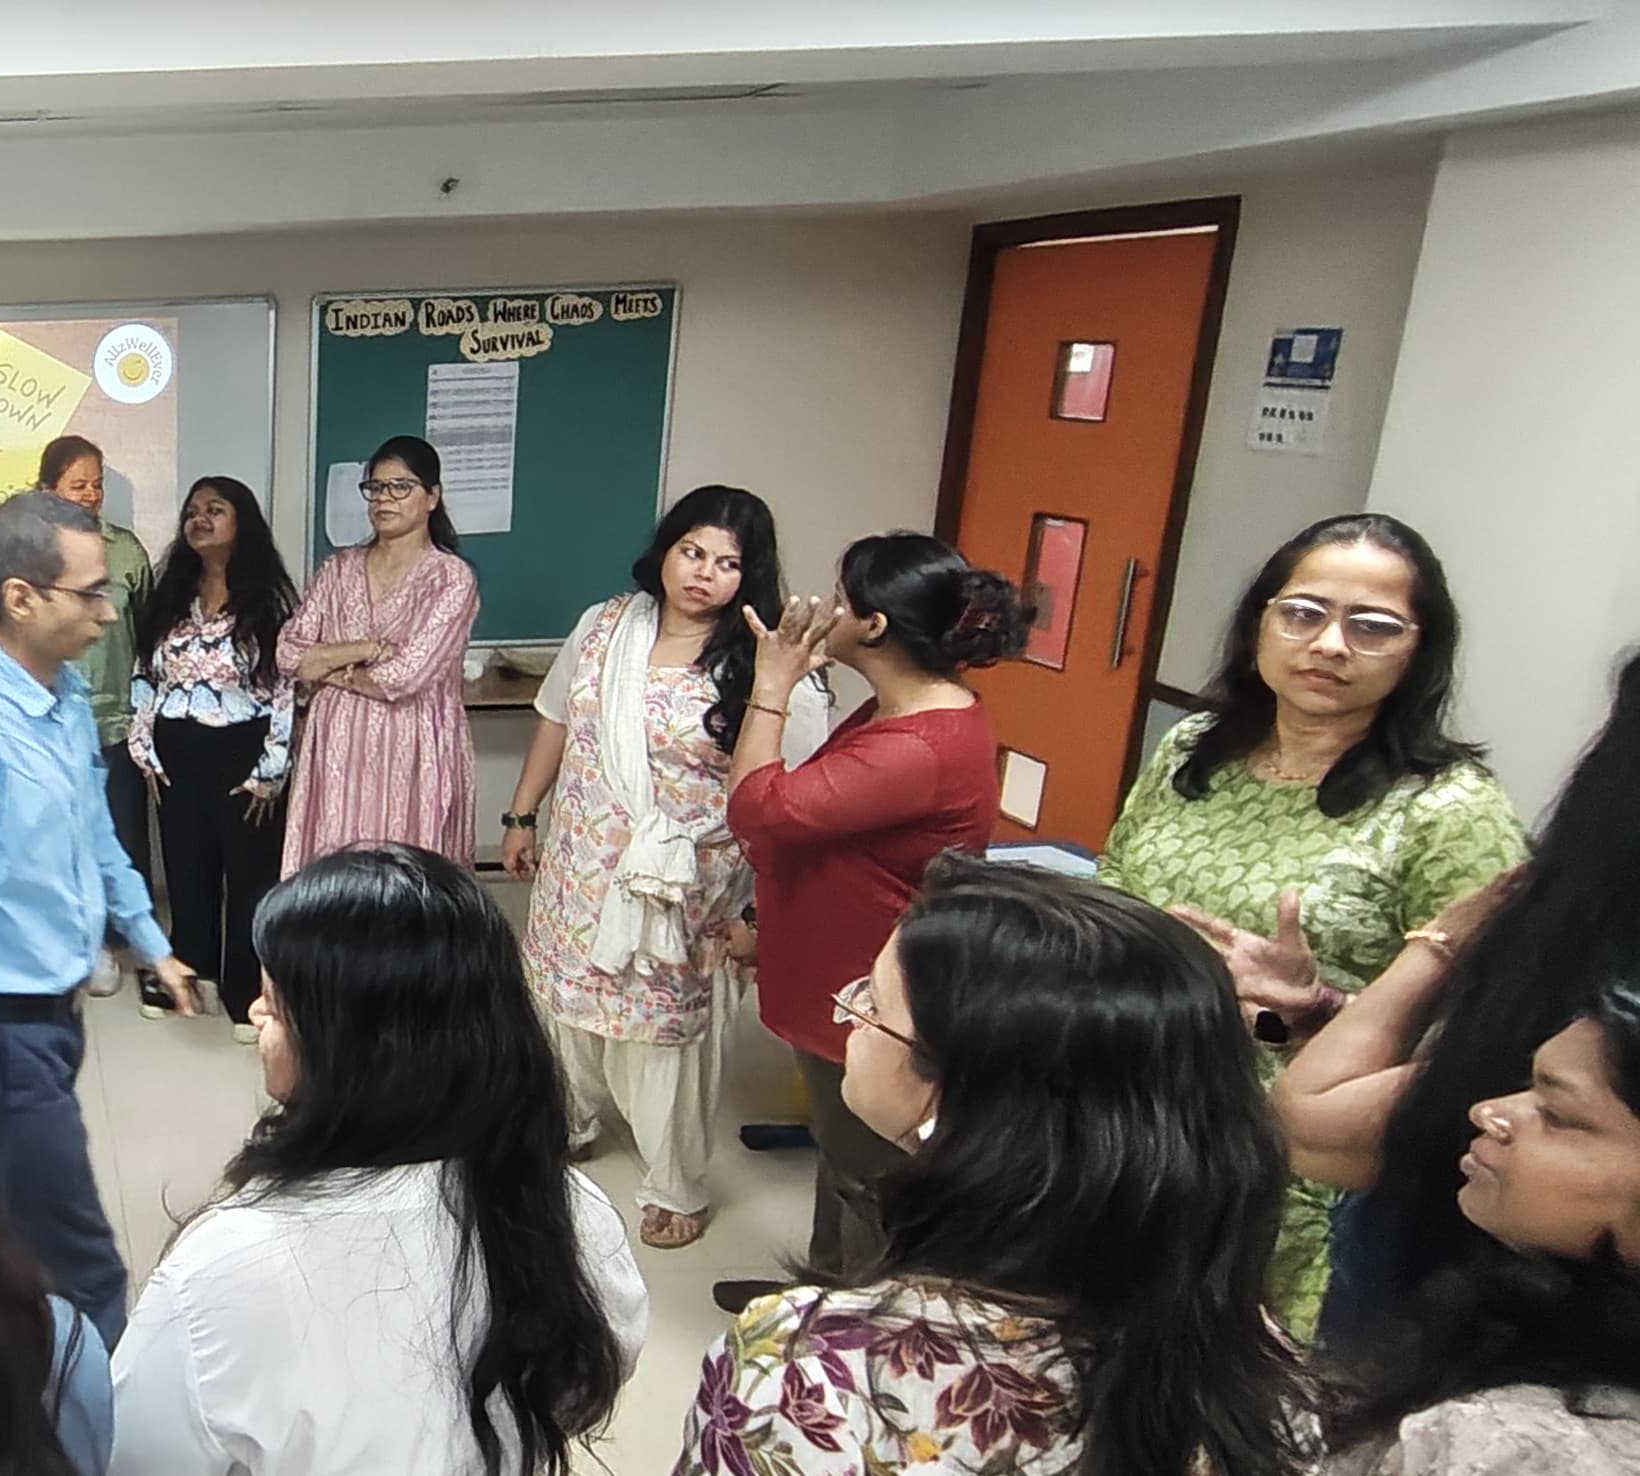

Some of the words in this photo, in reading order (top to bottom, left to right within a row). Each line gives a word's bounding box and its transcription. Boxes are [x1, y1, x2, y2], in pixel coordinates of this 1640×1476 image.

[331, 307, 408, 331] INDIAN
[423, 301, 476, 329] ROADS
[492, 302, 538, 324] WHERE
[549, 296, 595, 321] CHAOS
[613, 293, 659, 316] MEETS
[469, 328, 546, 355] SURVIVAL
